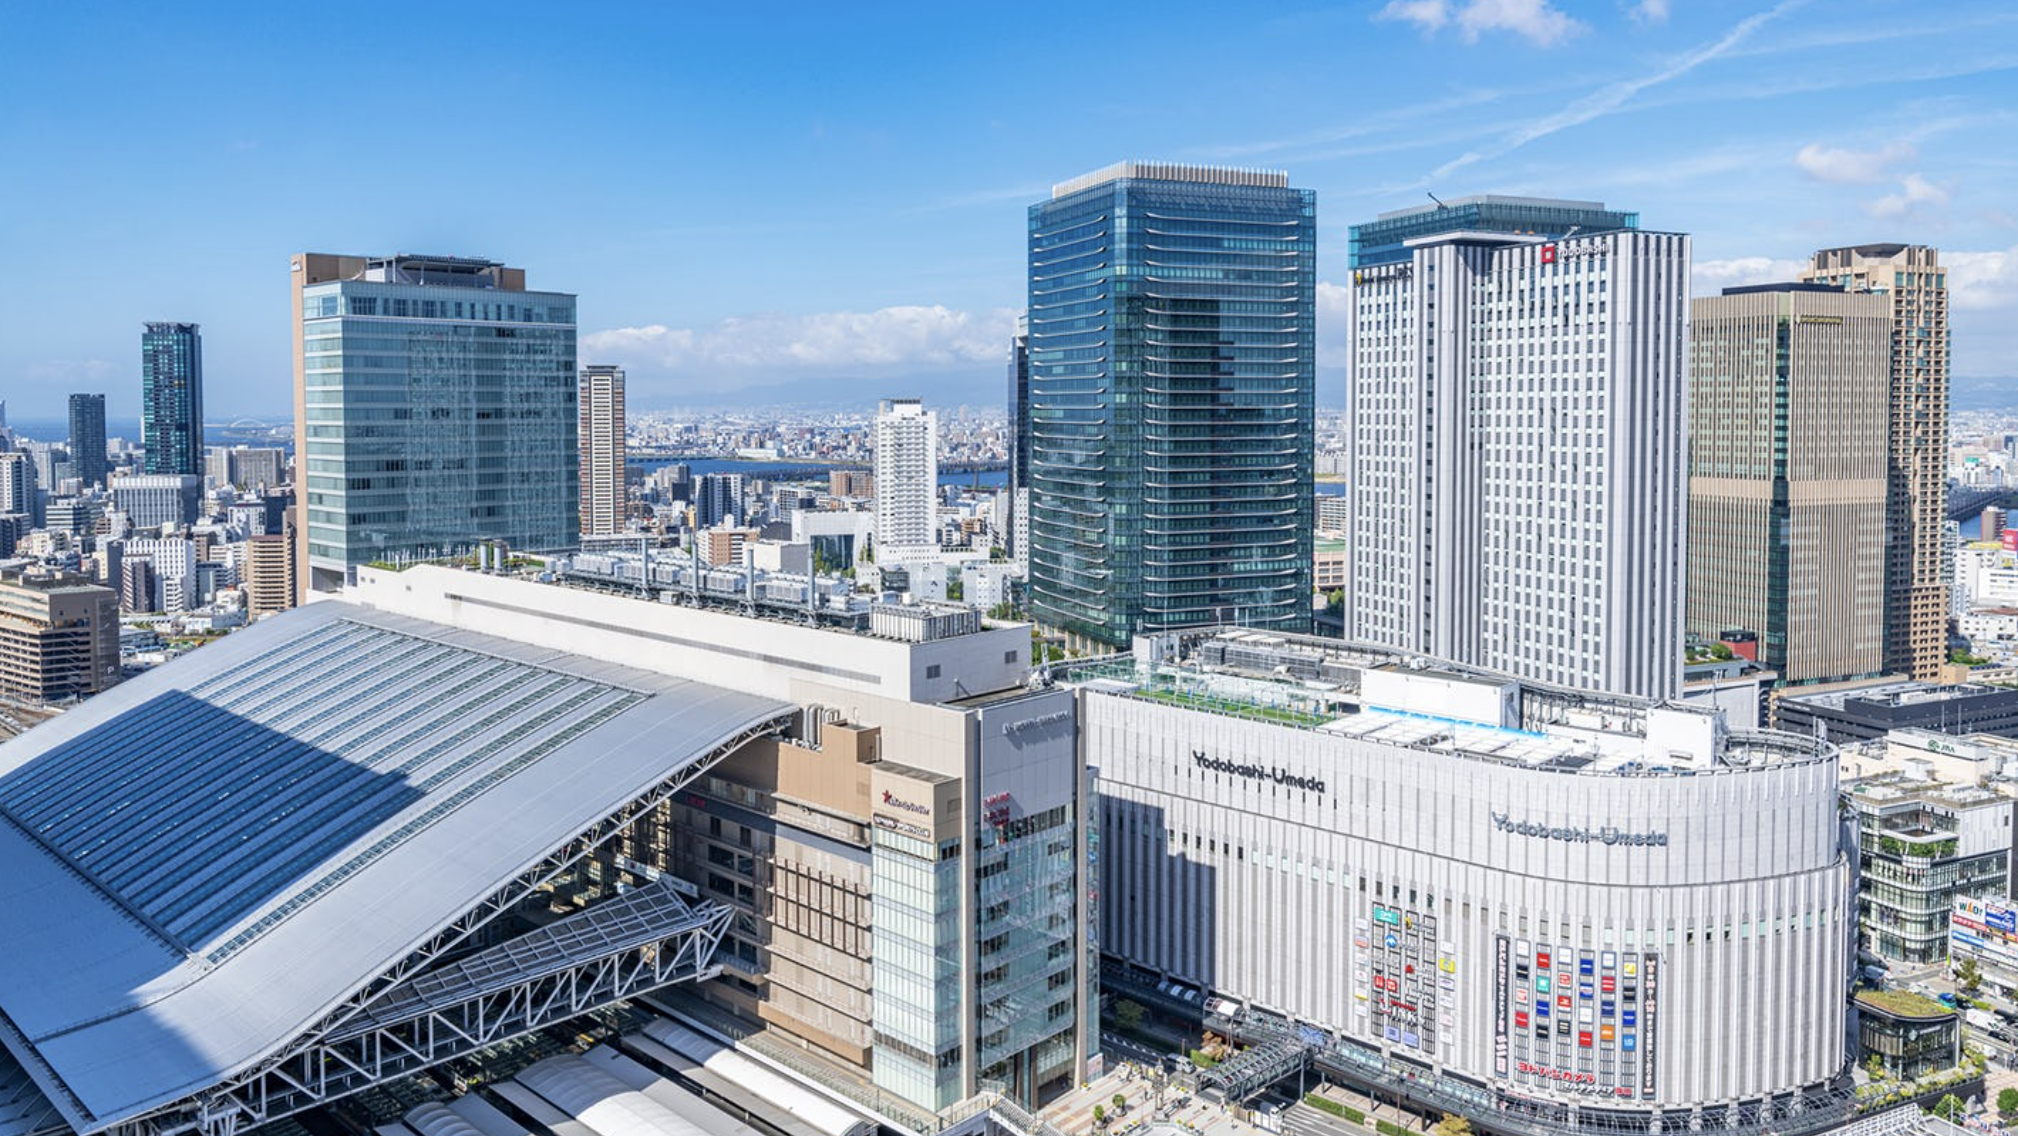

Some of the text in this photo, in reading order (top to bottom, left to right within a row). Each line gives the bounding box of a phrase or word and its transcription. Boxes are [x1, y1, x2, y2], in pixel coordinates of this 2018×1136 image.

[1940, 744, 1956, 754] JRA
[1192, 749, 1326, 794] Yodobashi-Umeda
[1491, 810, 1668, 846] Yodobashi-Umeda
